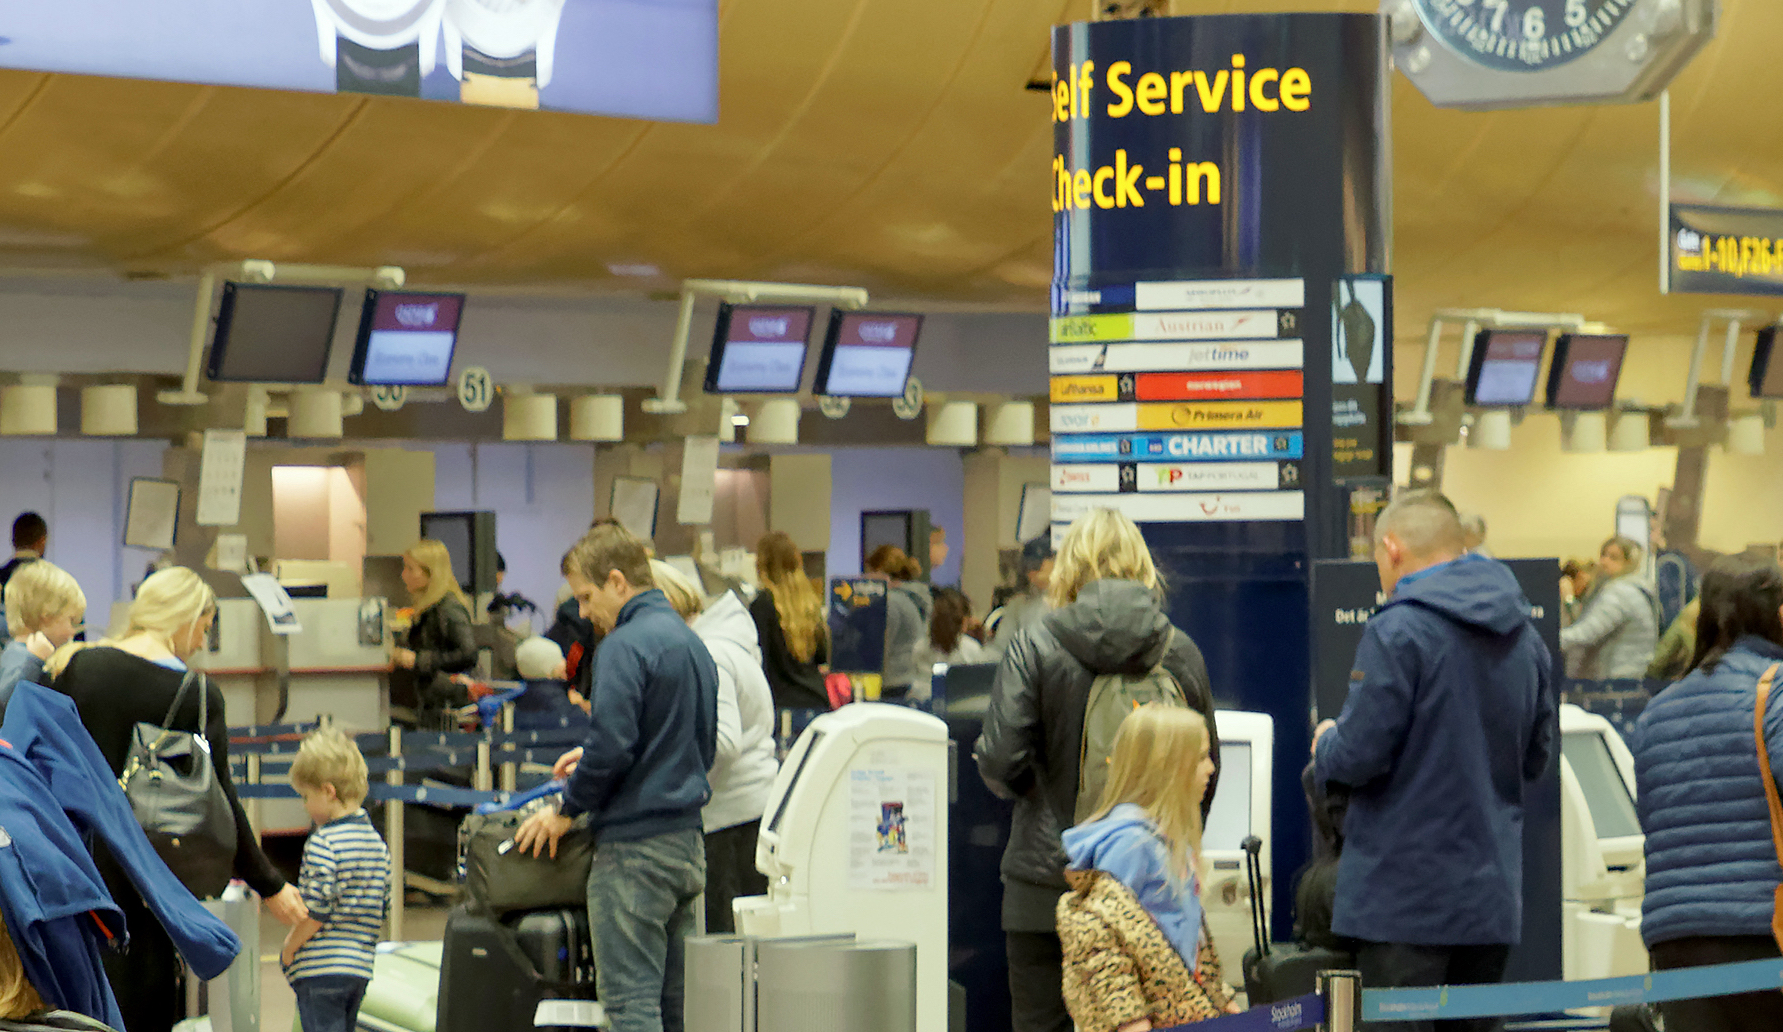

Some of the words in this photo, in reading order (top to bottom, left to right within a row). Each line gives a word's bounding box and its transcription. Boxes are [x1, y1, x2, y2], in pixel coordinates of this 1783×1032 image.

[1522, 6, 1545, 39] 6
[1106, 53, 1312, 118] Service
[1155, 318, 1225, 334] Austrian
[465, 373, 486, 403] 51
[1168, 434, 1268, 456] CHARTER
